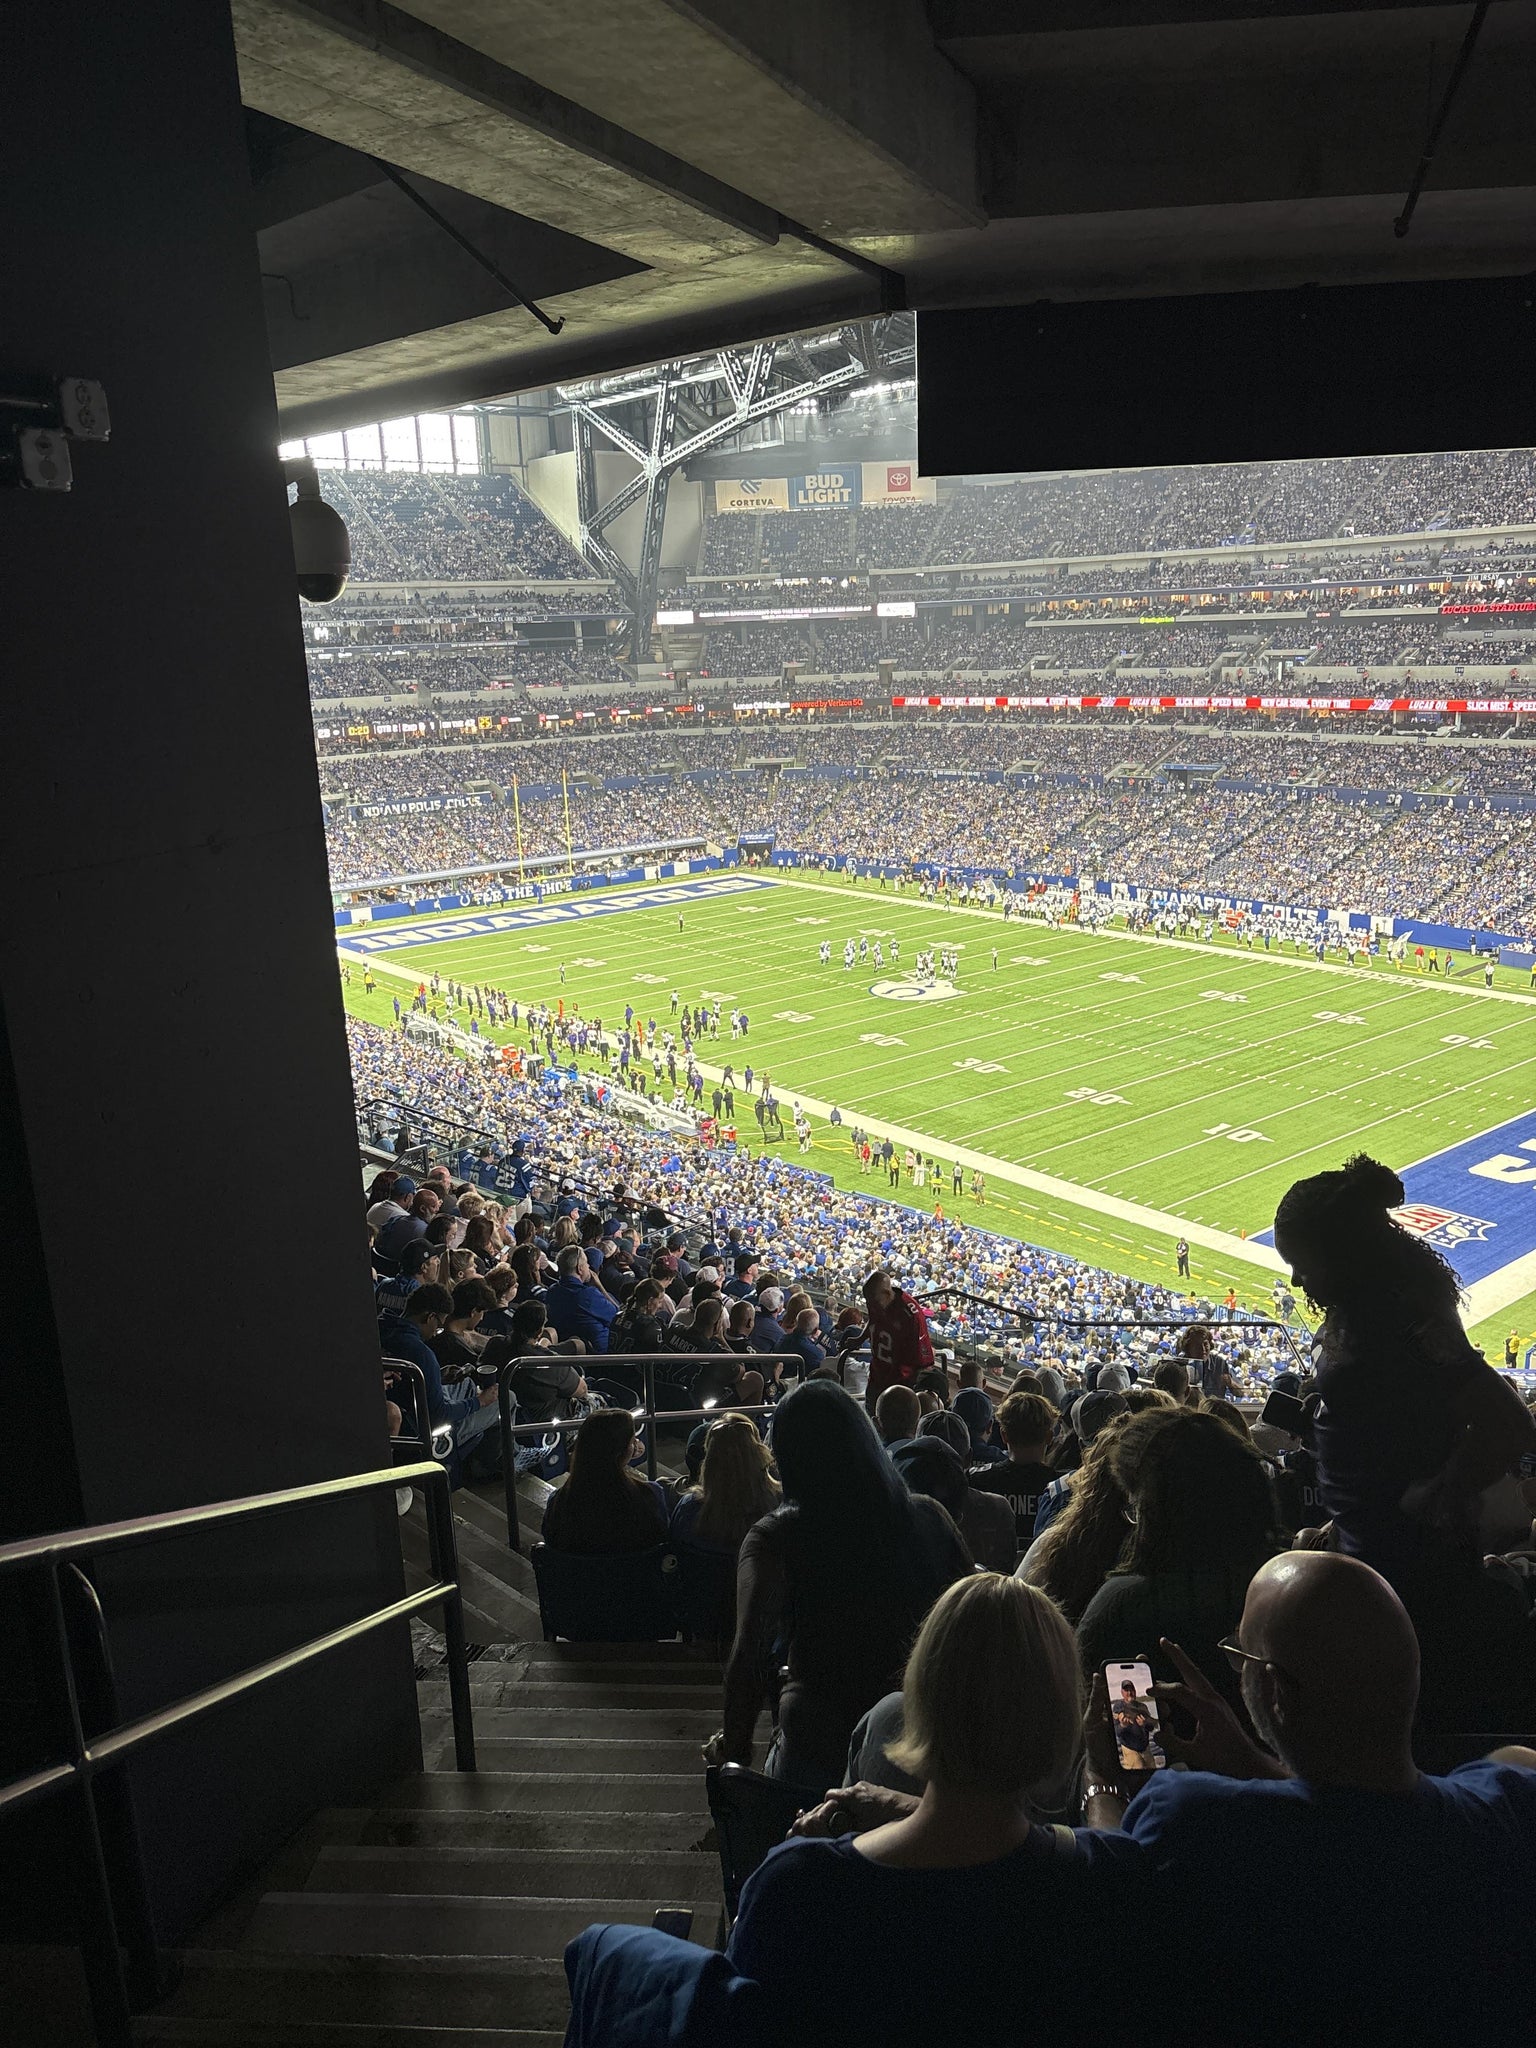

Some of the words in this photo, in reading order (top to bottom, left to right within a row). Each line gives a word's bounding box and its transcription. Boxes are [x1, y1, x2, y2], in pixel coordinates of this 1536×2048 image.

[805, 475, 844, 489] BUD
[730, 499, 774, 507] CORTEVA
[798, 488, 852, 504] LIGHT
[1480, 573, 1499, 581] IRSAY
[1442, 605, 1470, 614] LUCAS
[1472, 604, 1488, 613] OIL
[1489, 602, 1536, 612] STADIUM
[733, 702, 753, 710] Lucas
[763, 700, 790, 709] Stadium
[791, 701, 818, 710] powered
[819, 701, 828, 709] by
[828, 699, 852, 708] Verizon
[853, 698, 863, 706] 5G
[1211, 698, 1231, 707] SPEED
[1311, 699, 1331, 708] EVERY
[1408, 700, 1434, 710] LUCAS
[1434, 700, 1448, 710] OIL
[1466, 701, 1489, 711] SLICK
[363, 800, 441, 818] NDIANAPOLIS
[505, 885, 534, 901] THE
[351, 877, 762, 951] INDIANAPOLIS
[772, 1010, 815, 1023] 50
[858, 1033, 903, 1047] 40
[952, 1057, 1003, 1074] 30
[1064, 1086, 1125, 1106] 20
[1202, 1122, 1264, 1143] 10
[1395, 1208, 1453, 1232] NFL
[1004, 1493, 1041, 1516] ONE
